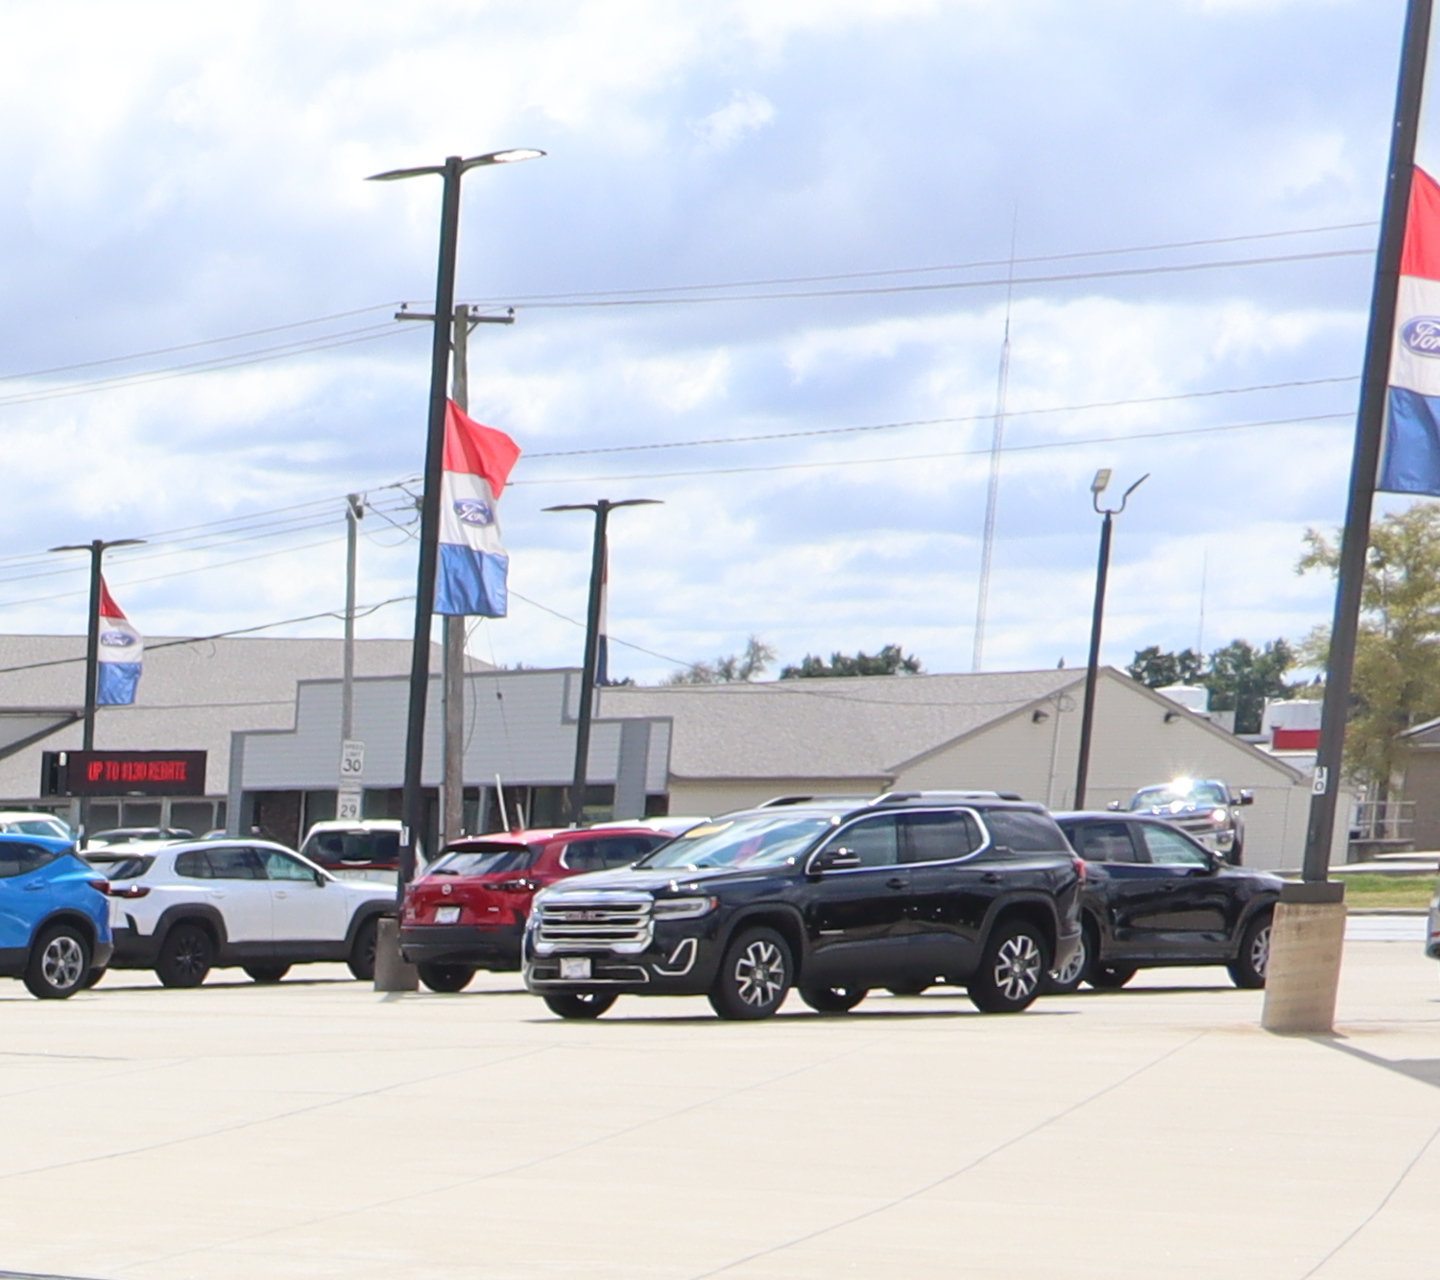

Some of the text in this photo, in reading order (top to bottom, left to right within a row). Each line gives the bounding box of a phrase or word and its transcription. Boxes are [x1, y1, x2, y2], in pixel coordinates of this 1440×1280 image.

[1410, 321, 1440, 350] For
[343, 758, 362, 772] 30
[341, 804, 358, 817] 29
